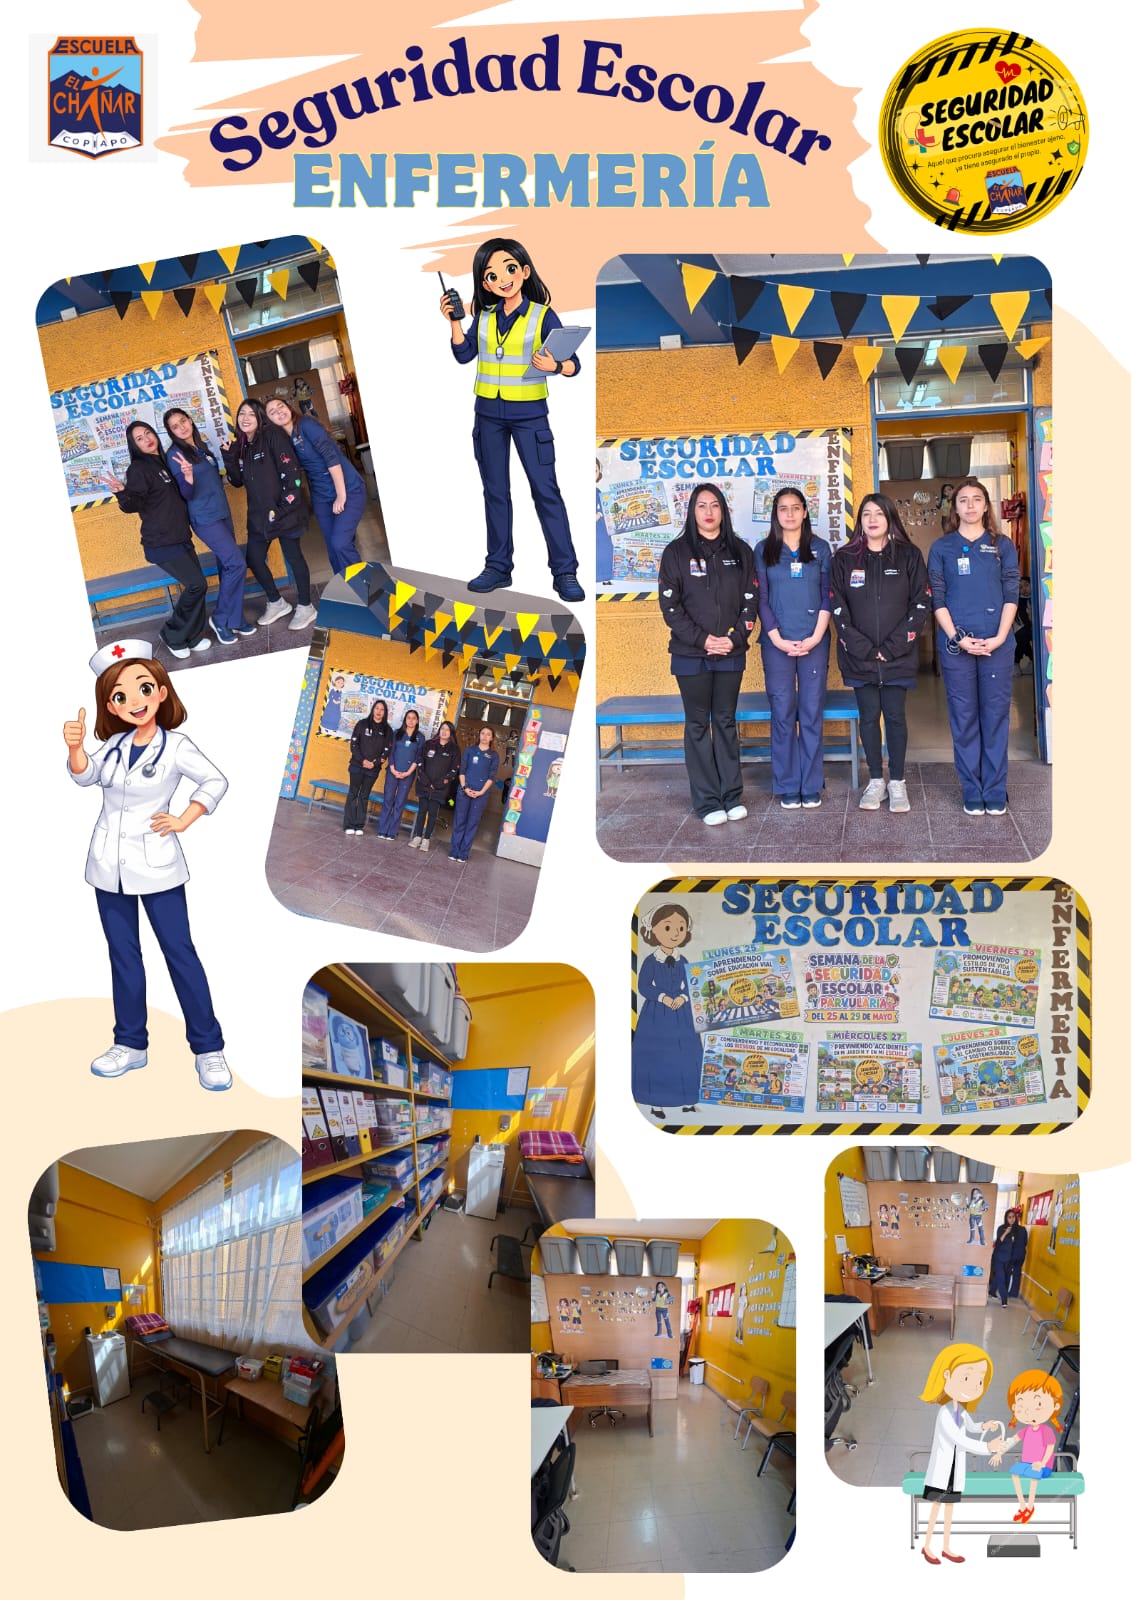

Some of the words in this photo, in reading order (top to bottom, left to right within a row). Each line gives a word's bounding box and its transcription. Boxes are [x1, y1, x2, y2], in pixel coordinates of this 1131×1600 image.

[50, 363, 178, 409] SEGURIDAD
[65, 383, 169, 420] ESCOLAR
[199, 354, 227, 438] ENFERMER
[620, 432, 796, 462] SEGURIDAD
[639, 456, 777, 480] ESCOLAR
[353, 674, 427, 696] SEGURIDAD
[360, 684, 415, 703] ESCOLAR
[721, 882, 1004, 916] SEGURIDAD
[752, 914, 972, 948] ESCOLAR
[708, 947, 741, 958] LUNES
[744, 944, 757, 952] 25
[975, 944, 1020, 956] VIERNES
[1023, 949, 1035, 957] 29
[713, 955, 762, 968] APRENDIENDO
[810, 954, 859, 967] SEMANA
[862, 954, 873, 965] DE
[874, 954, 886, 966] LA
[962, 954, 1010, 964] PROMOVIENDO
[963, 960, 988, 968] ESTILOS
[814, 966, 892, 981] SEGURIDAD
[962, 966, 1011, 976] SUSTENTABLES
[821, 982, 883, 995] ESCOLAR
[1049, 883, 1075, 1100] ENFERMERIA
[812, 999, 819, 1008] Y
[820, 998, 887, 1009] PARVULARIA
[811, 1012, 825, 1021] DEL
[826, 1012, 838, 1021] 25
[840, 1012, 849, 1021] AL
[862, 1012, 871, 1021] DE
[872, 1012, 892, 1021] MAYO
[739, 1029, 780, 1040] MARTES
[785, 1032, 797, 1040] 26
[833, 1030, 888, 1040] MIÉRCOLES
[948, 1030, 985, 1042] JUEVES
